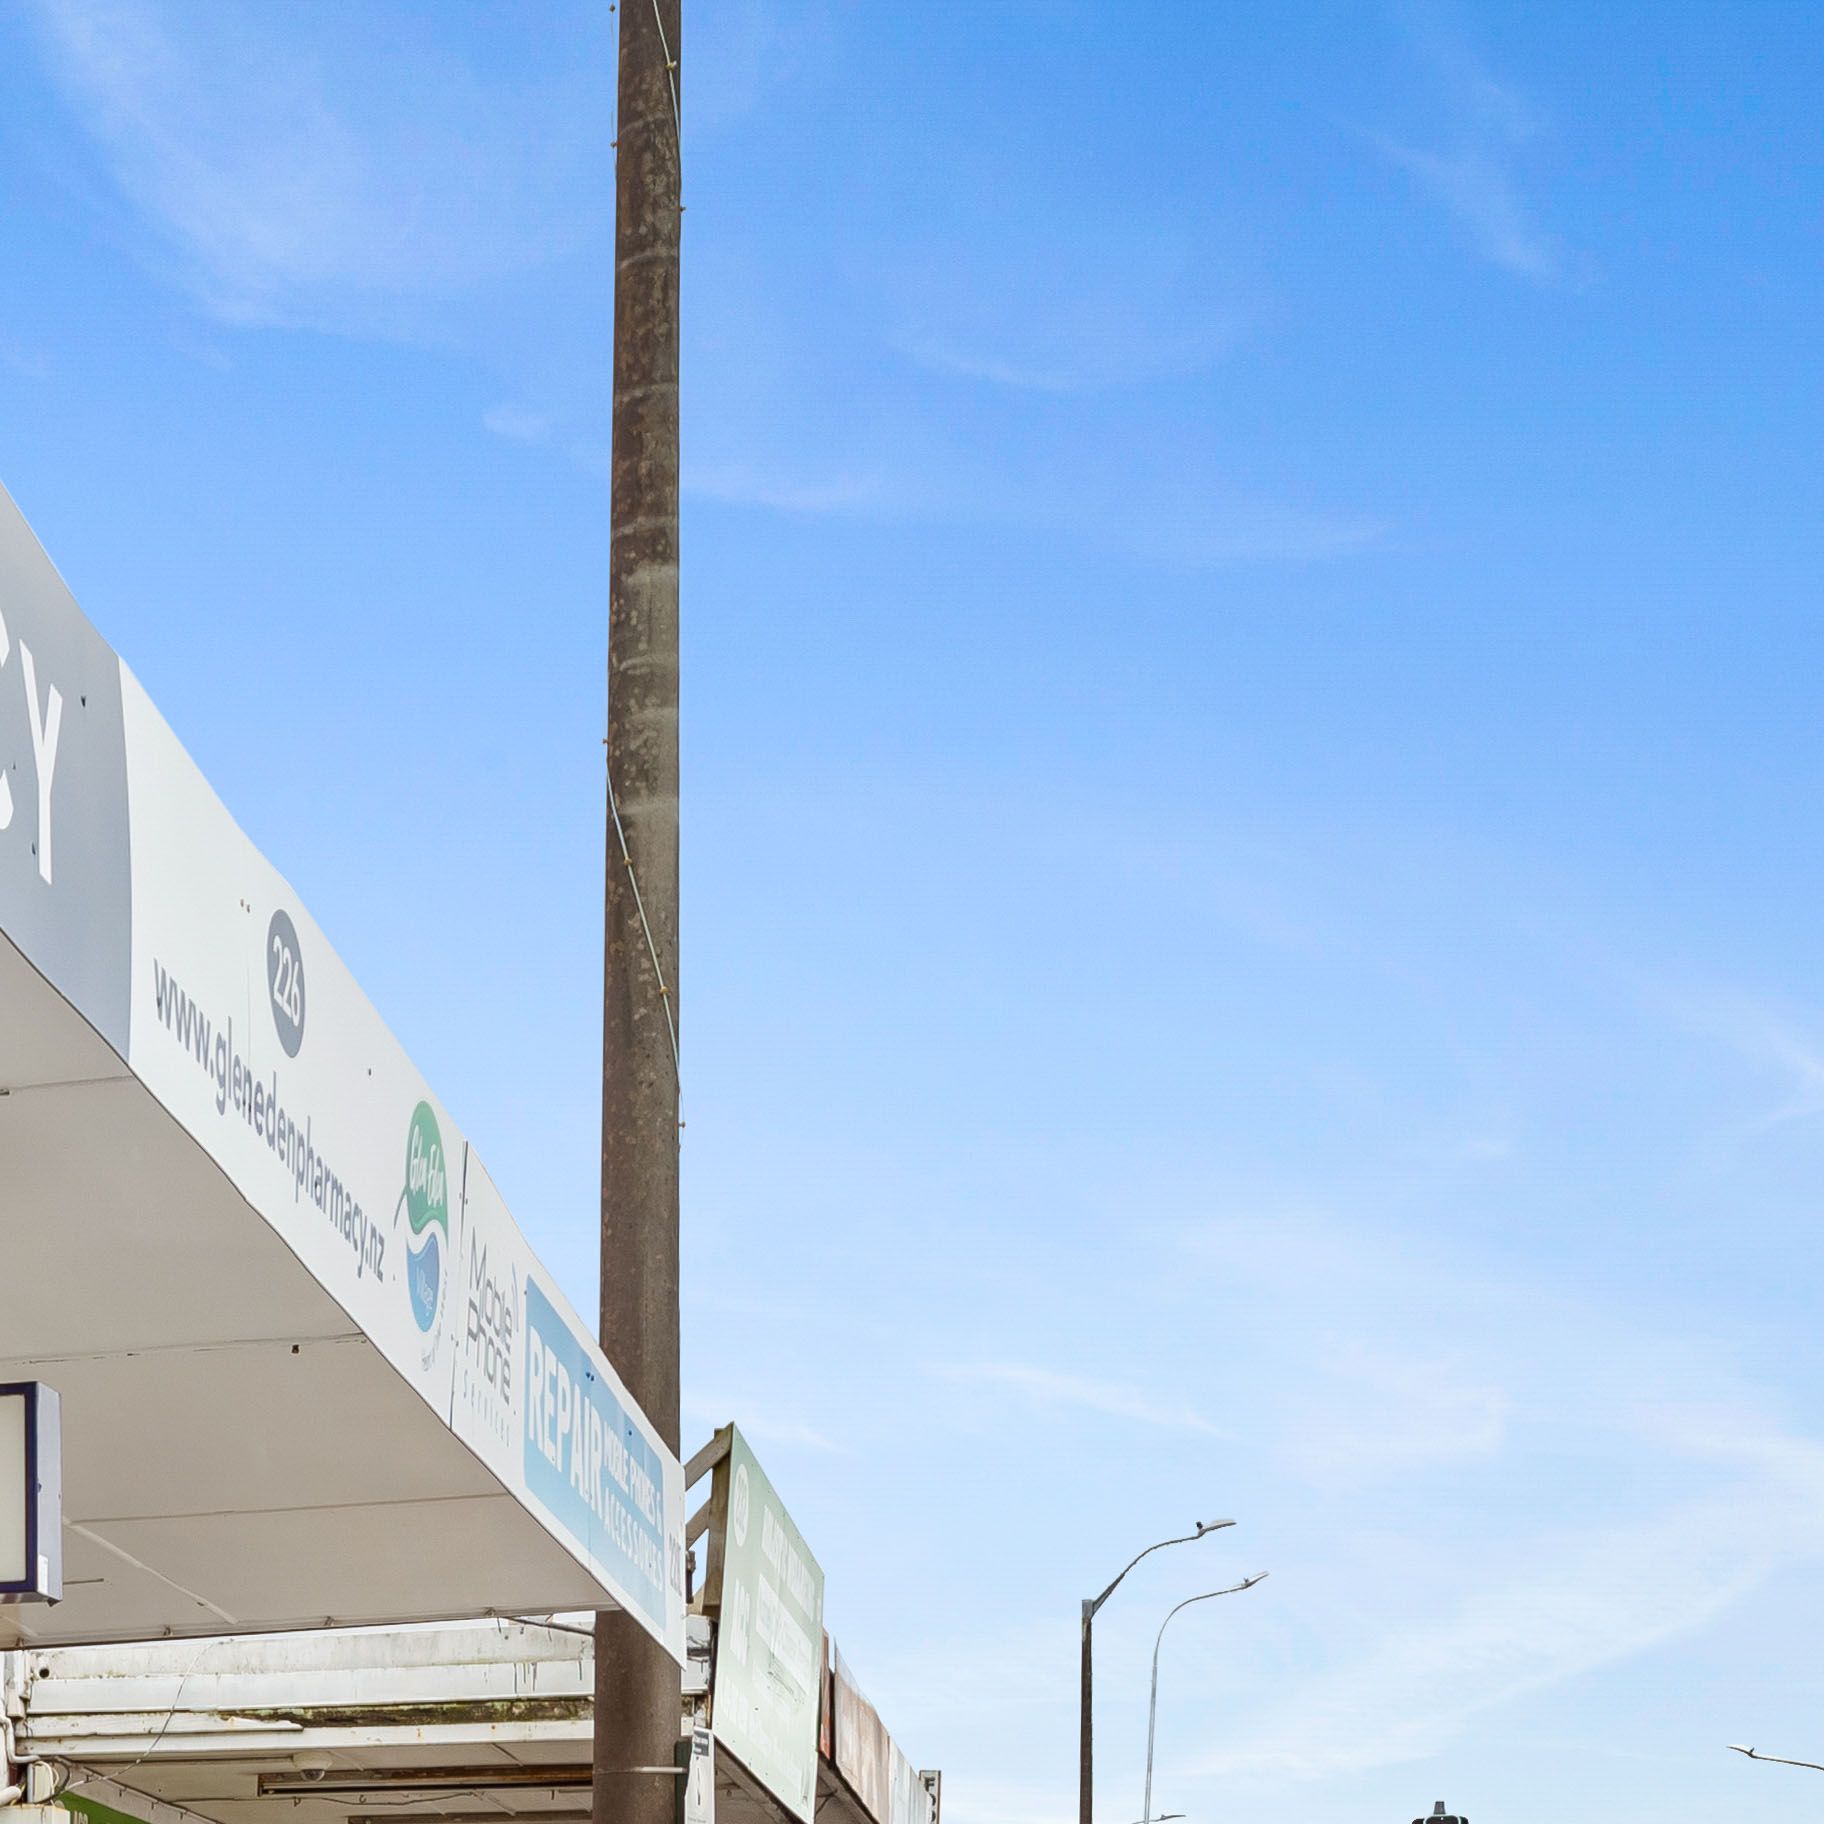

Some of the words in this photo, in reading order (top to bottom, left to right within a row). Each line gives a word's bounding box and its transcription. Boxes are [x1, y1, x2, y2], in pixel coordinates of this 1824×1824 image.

[271, 933, 304, 1029] 226
[153, 957, 385, 1284] www.glenedenpharmacy.nz
[528, 1325, 604, 1520] REPAIR
